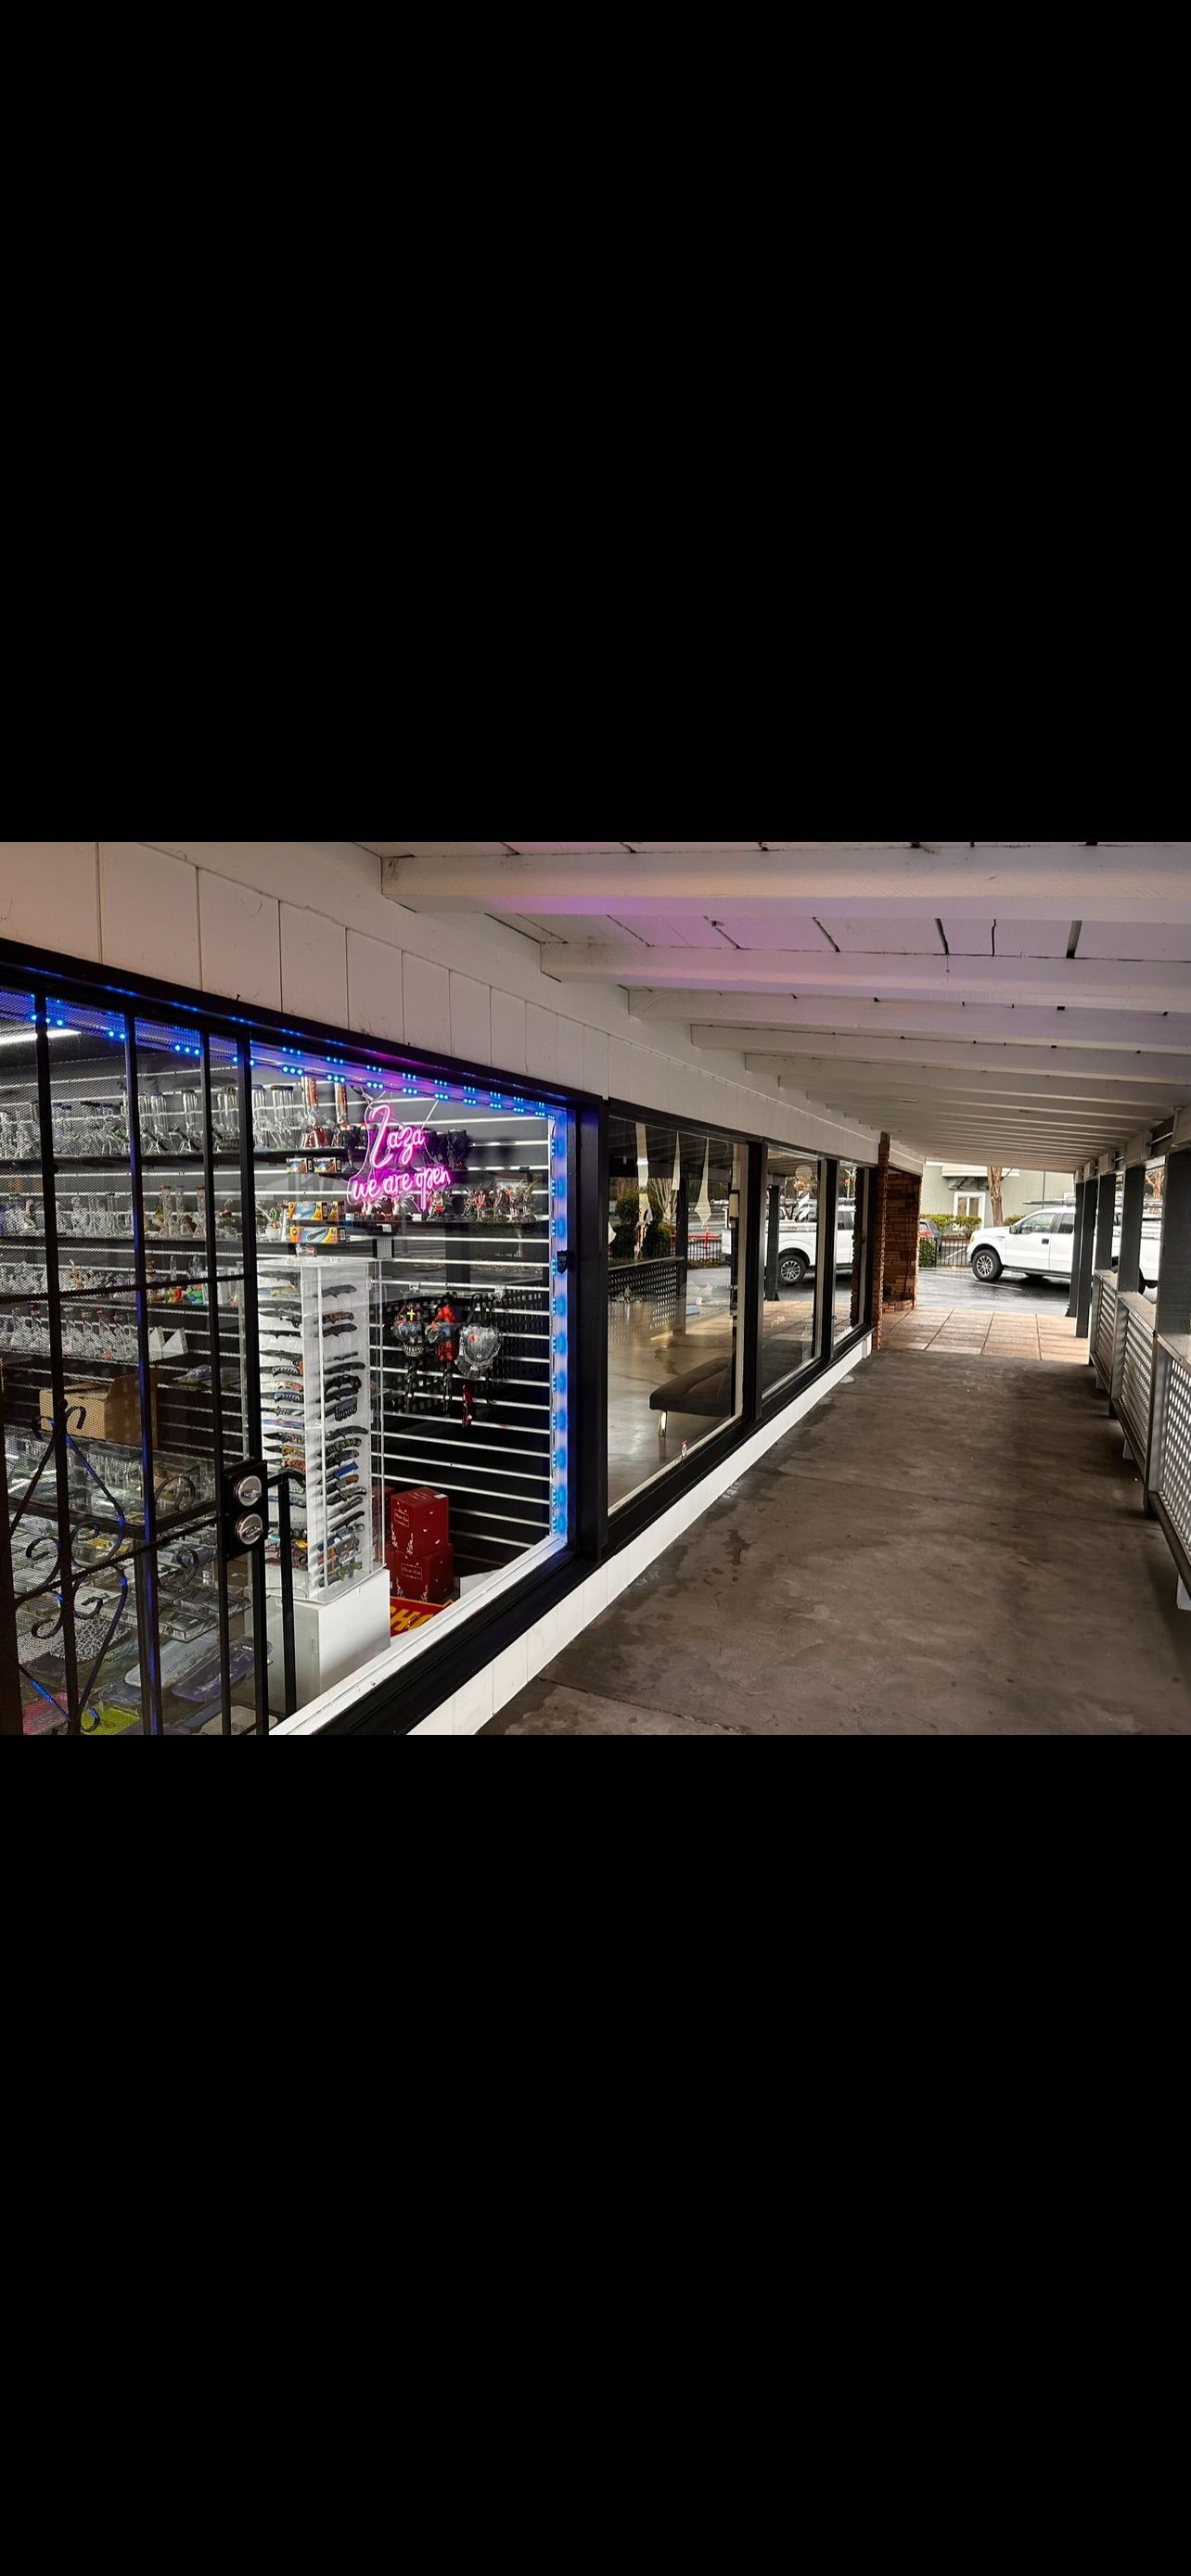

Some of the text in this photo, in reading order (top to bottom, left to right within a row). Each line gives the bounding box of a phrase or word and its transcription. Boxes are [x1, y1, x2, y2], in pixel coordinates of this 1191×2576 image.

[369, 1103, 426, 1168] Zaza
[352, 1166, 452, 1211] we are open
